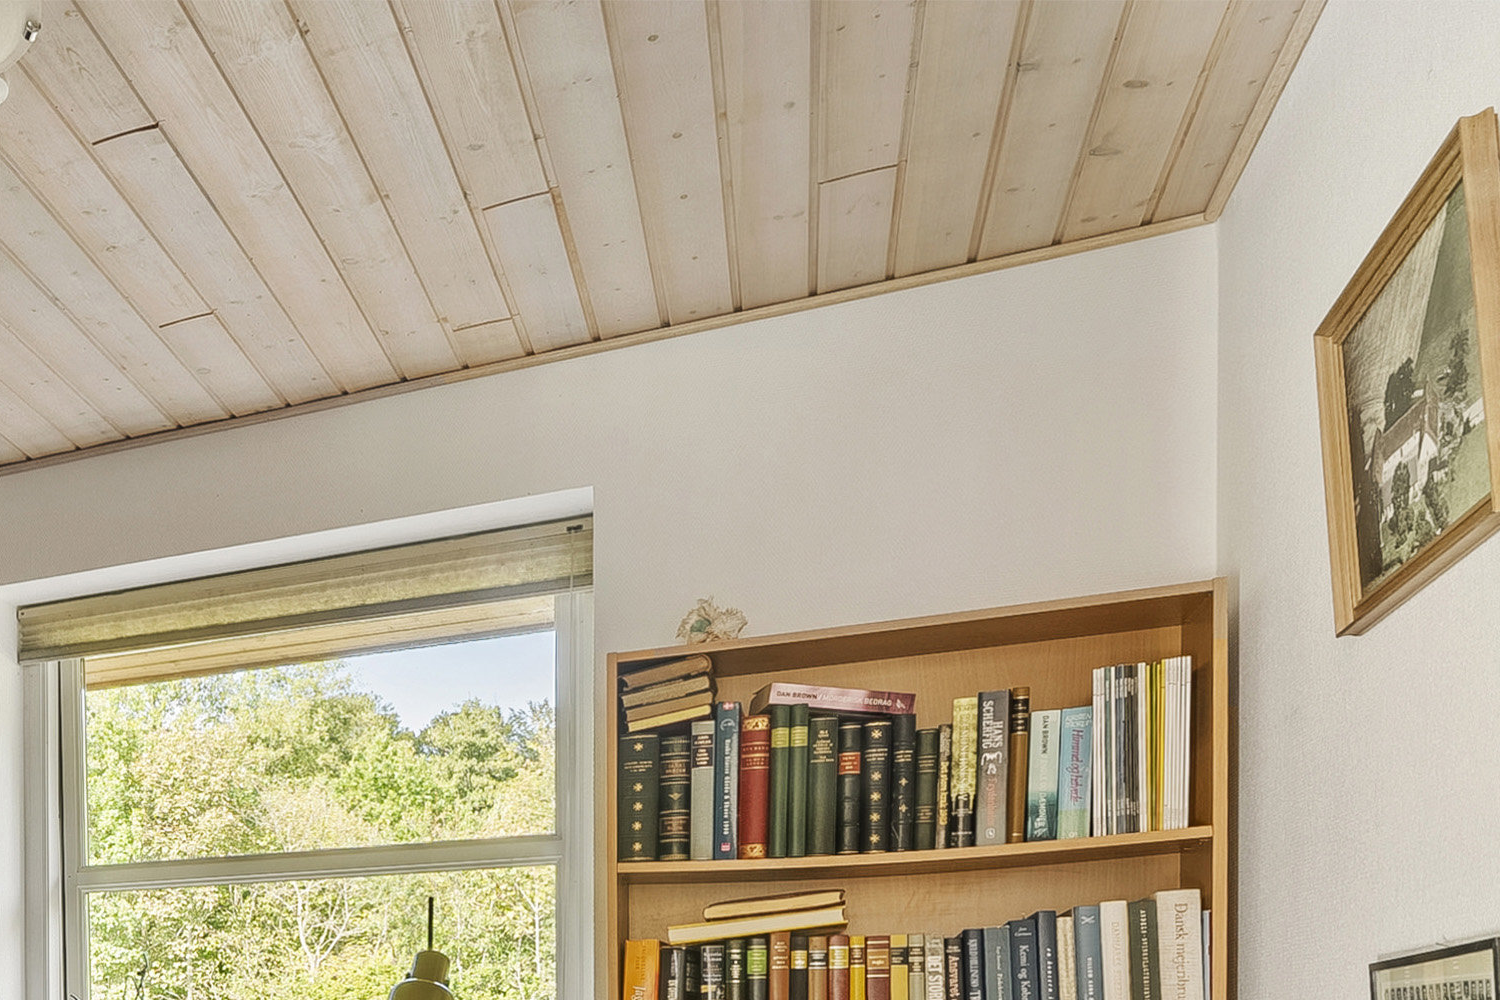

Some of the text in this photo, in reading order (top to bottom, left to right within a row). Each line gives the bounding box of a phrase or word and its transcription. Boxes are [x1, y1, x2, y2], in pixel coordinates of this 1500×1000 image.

[983, 701, 992, 749] SCHERFIG
[993, 721, 1002, 747] HANS
[1041, 715, 1049, 754] DAN BROWN
[1174, 903, 1188, 940] Dansk
[929, 956, 941, 973] DET
[1020, 945, 1030, 966] Kemi
[948, 955, 960, 997] Ansvaret
[1018, 968, 1028, 979] og
